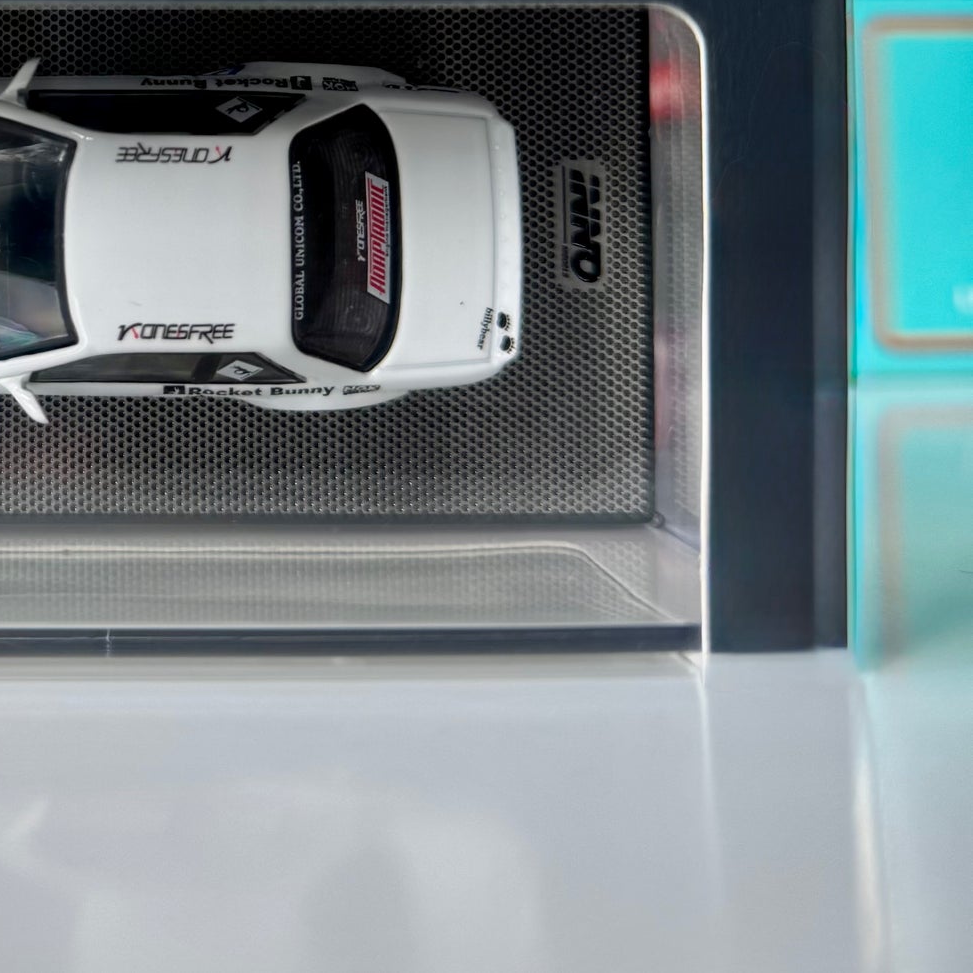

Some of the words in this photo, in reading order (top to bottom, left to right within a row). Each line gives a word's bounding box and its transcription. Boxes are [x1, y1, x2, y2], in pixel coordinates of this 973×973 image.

[140, 76, 208, 90] Bunny
[217, 77, 289, 89] Rocket
[293, 215, 305, 268] UNICOM
[294, 270, 306, 321] GLOBAL
[477, 306, 494, 351] billybear
[187, 386, 263, 397] Rocket
[270, 384, 335, 396] Bunny
